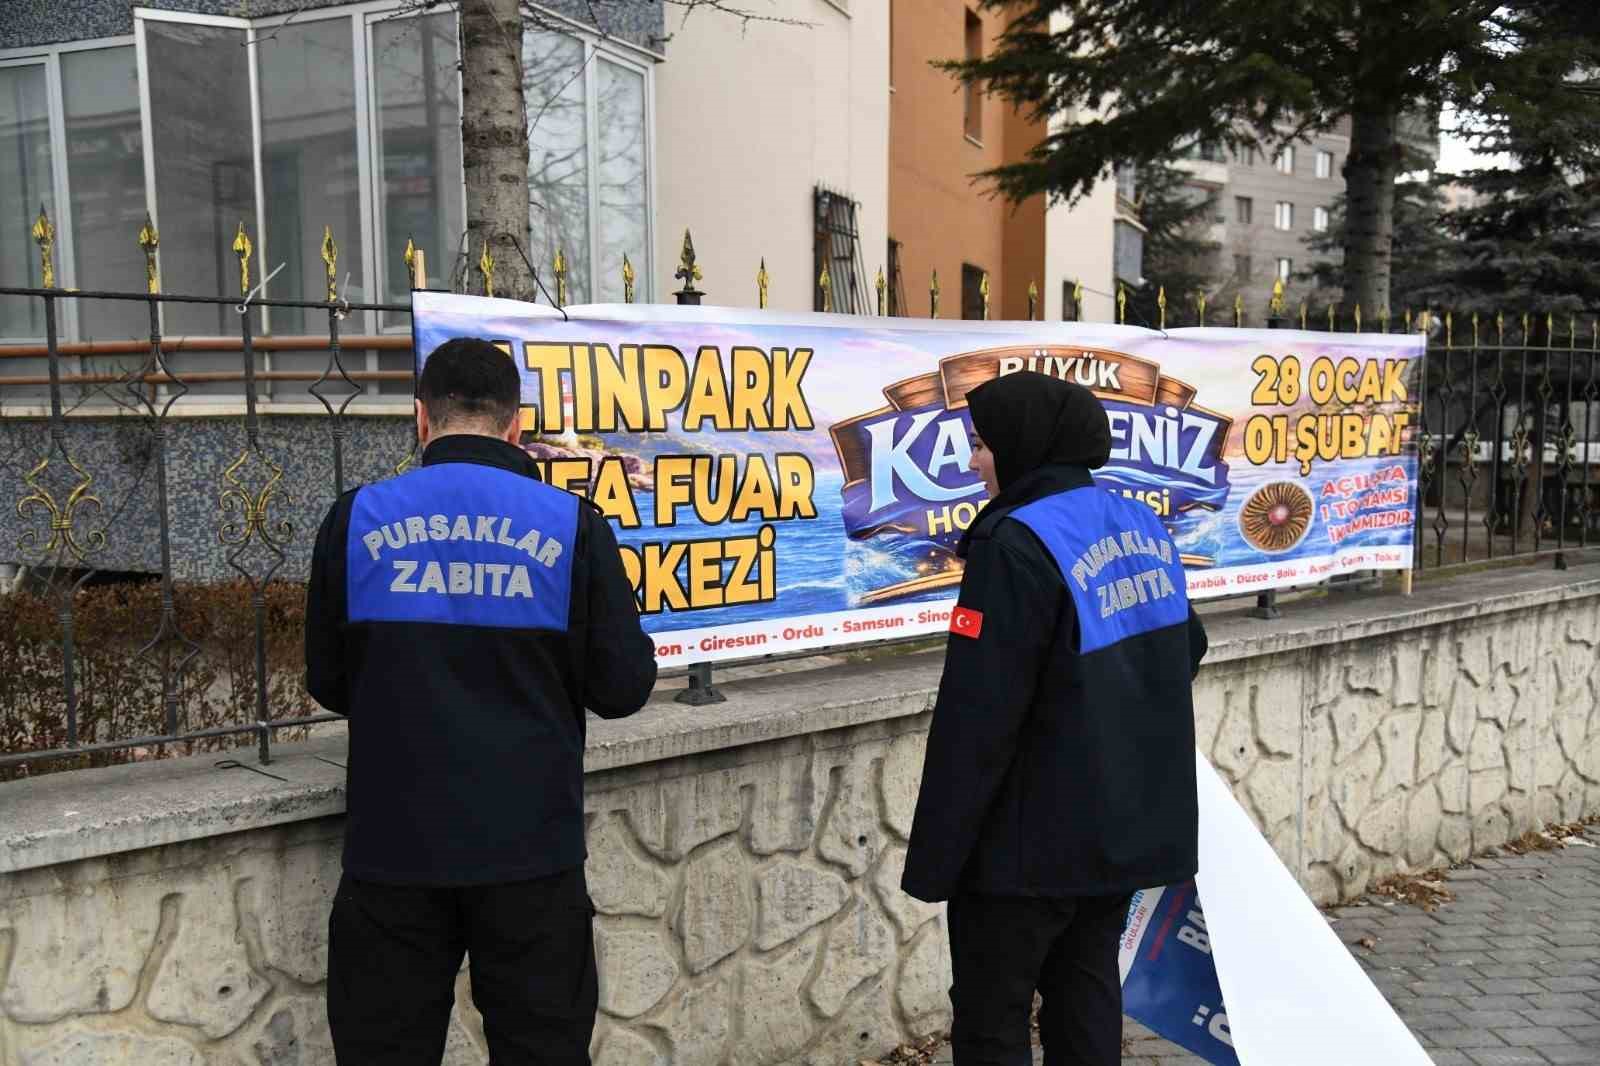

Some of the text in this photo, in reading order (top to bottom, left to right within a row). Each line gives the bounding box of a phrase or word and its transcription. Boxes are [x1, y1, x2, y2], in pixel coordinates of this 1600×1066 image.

[1251, 355, 1408, 405] 28 OCAK
[1244, 412, 1408, 477] 01 ŞUBAT
[655, 454, 817, 527] FUAR
[363, 514, 562, 568] PURSAKLAR
[390, 560, 533, 598] ZABITA
[1096, 567, 1176, 618] ZABITA
[700, 633, 767, 652] Giresun
[783, 625, 824, 641] Ordu
[842, 615, 904, 633] Samsun
[918, 609, 953, 624] Sino
[1185, 576, 1226, 590] arabük
[1237, 572, 1268, 584] Düzce
